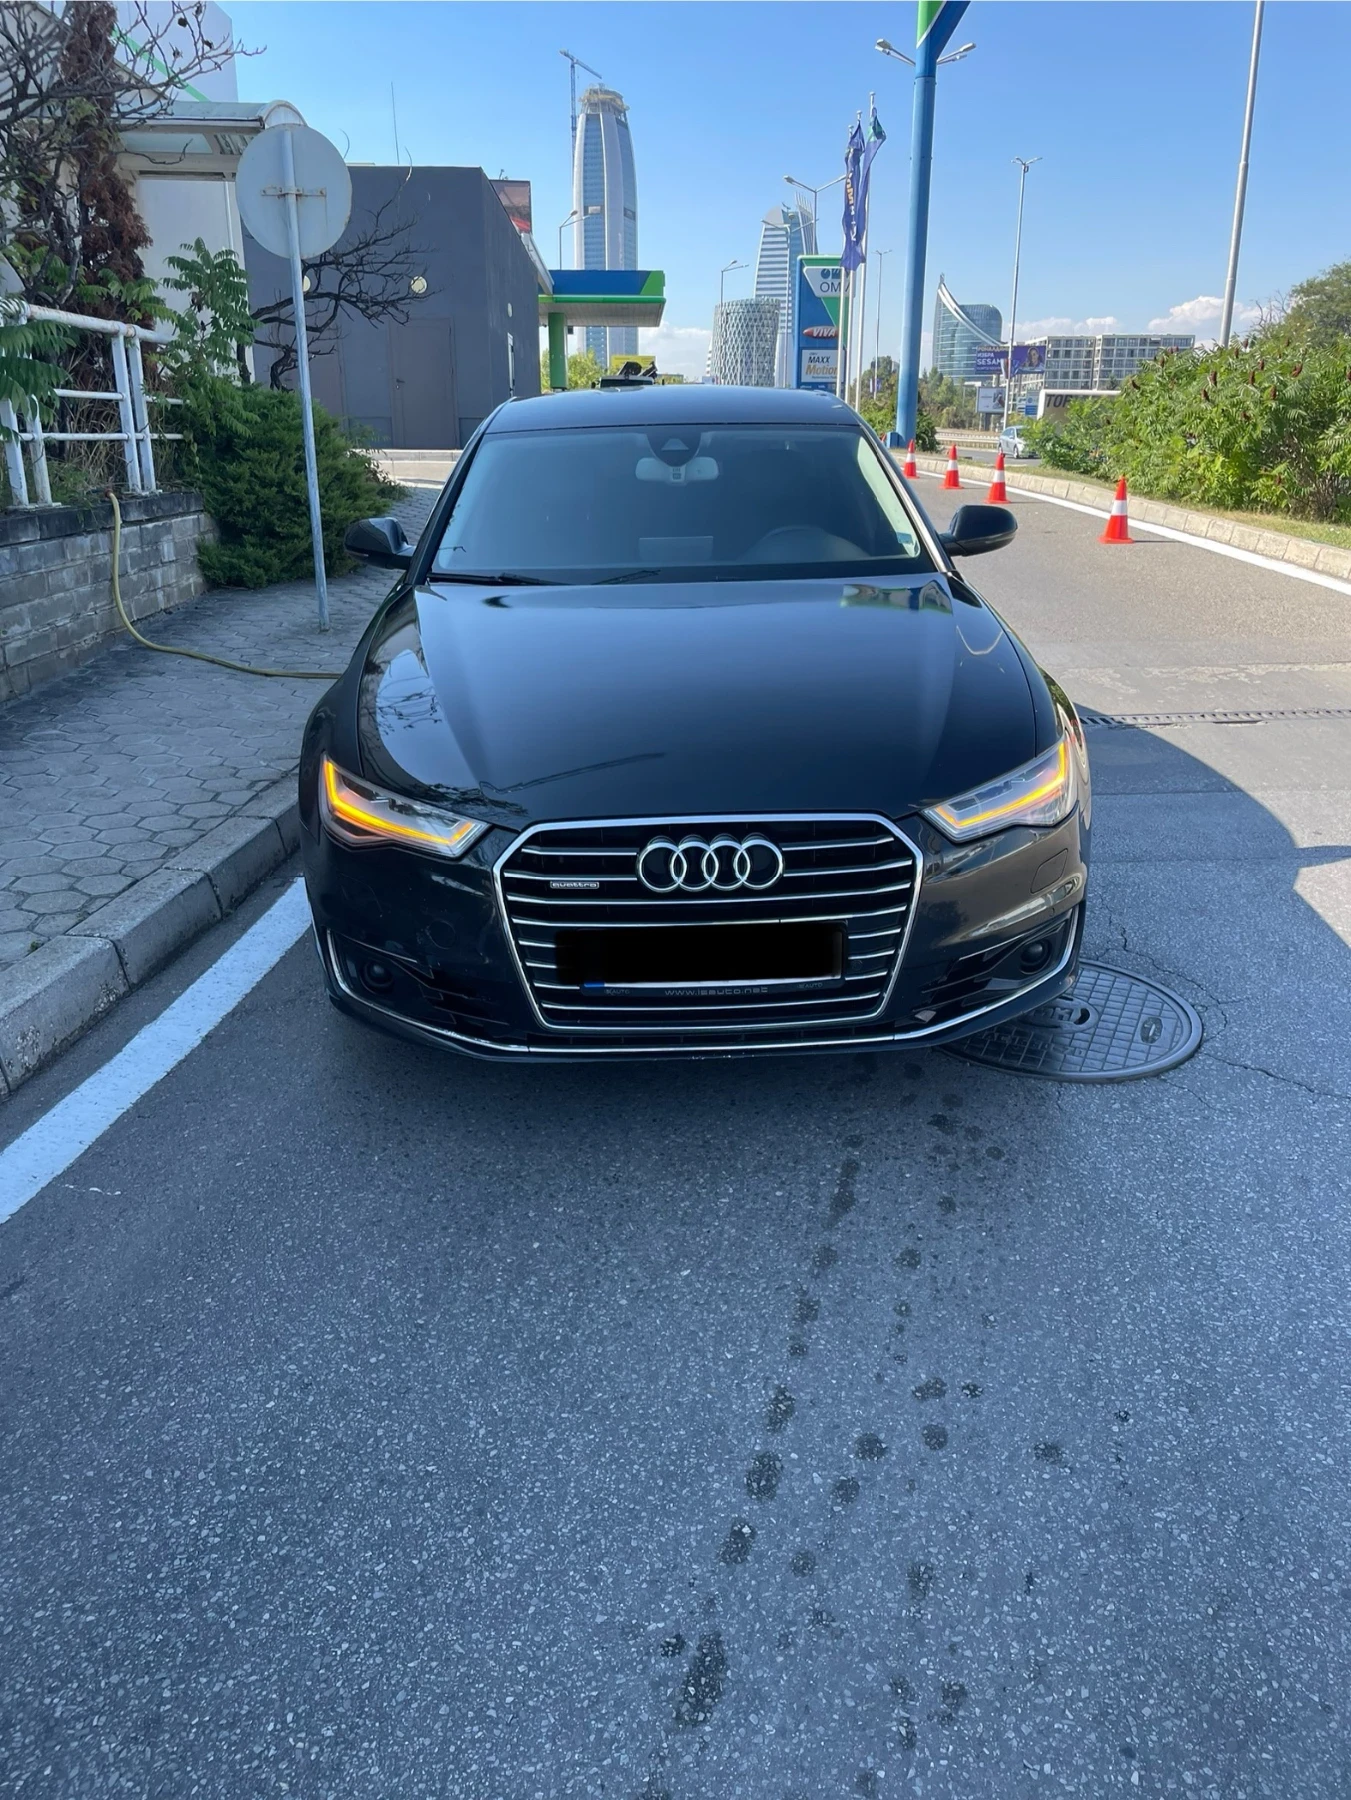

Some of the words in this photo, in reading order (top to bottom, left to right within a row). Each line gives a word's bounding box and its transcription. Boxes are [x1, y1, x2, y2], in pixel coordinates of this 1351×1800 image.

[812, 328, 836, 337] VIVA
[808, 356, 831, 364] MAXX
[977, 358, 1002, 366] SESAM
[551, 881, 598, 889] quattro
